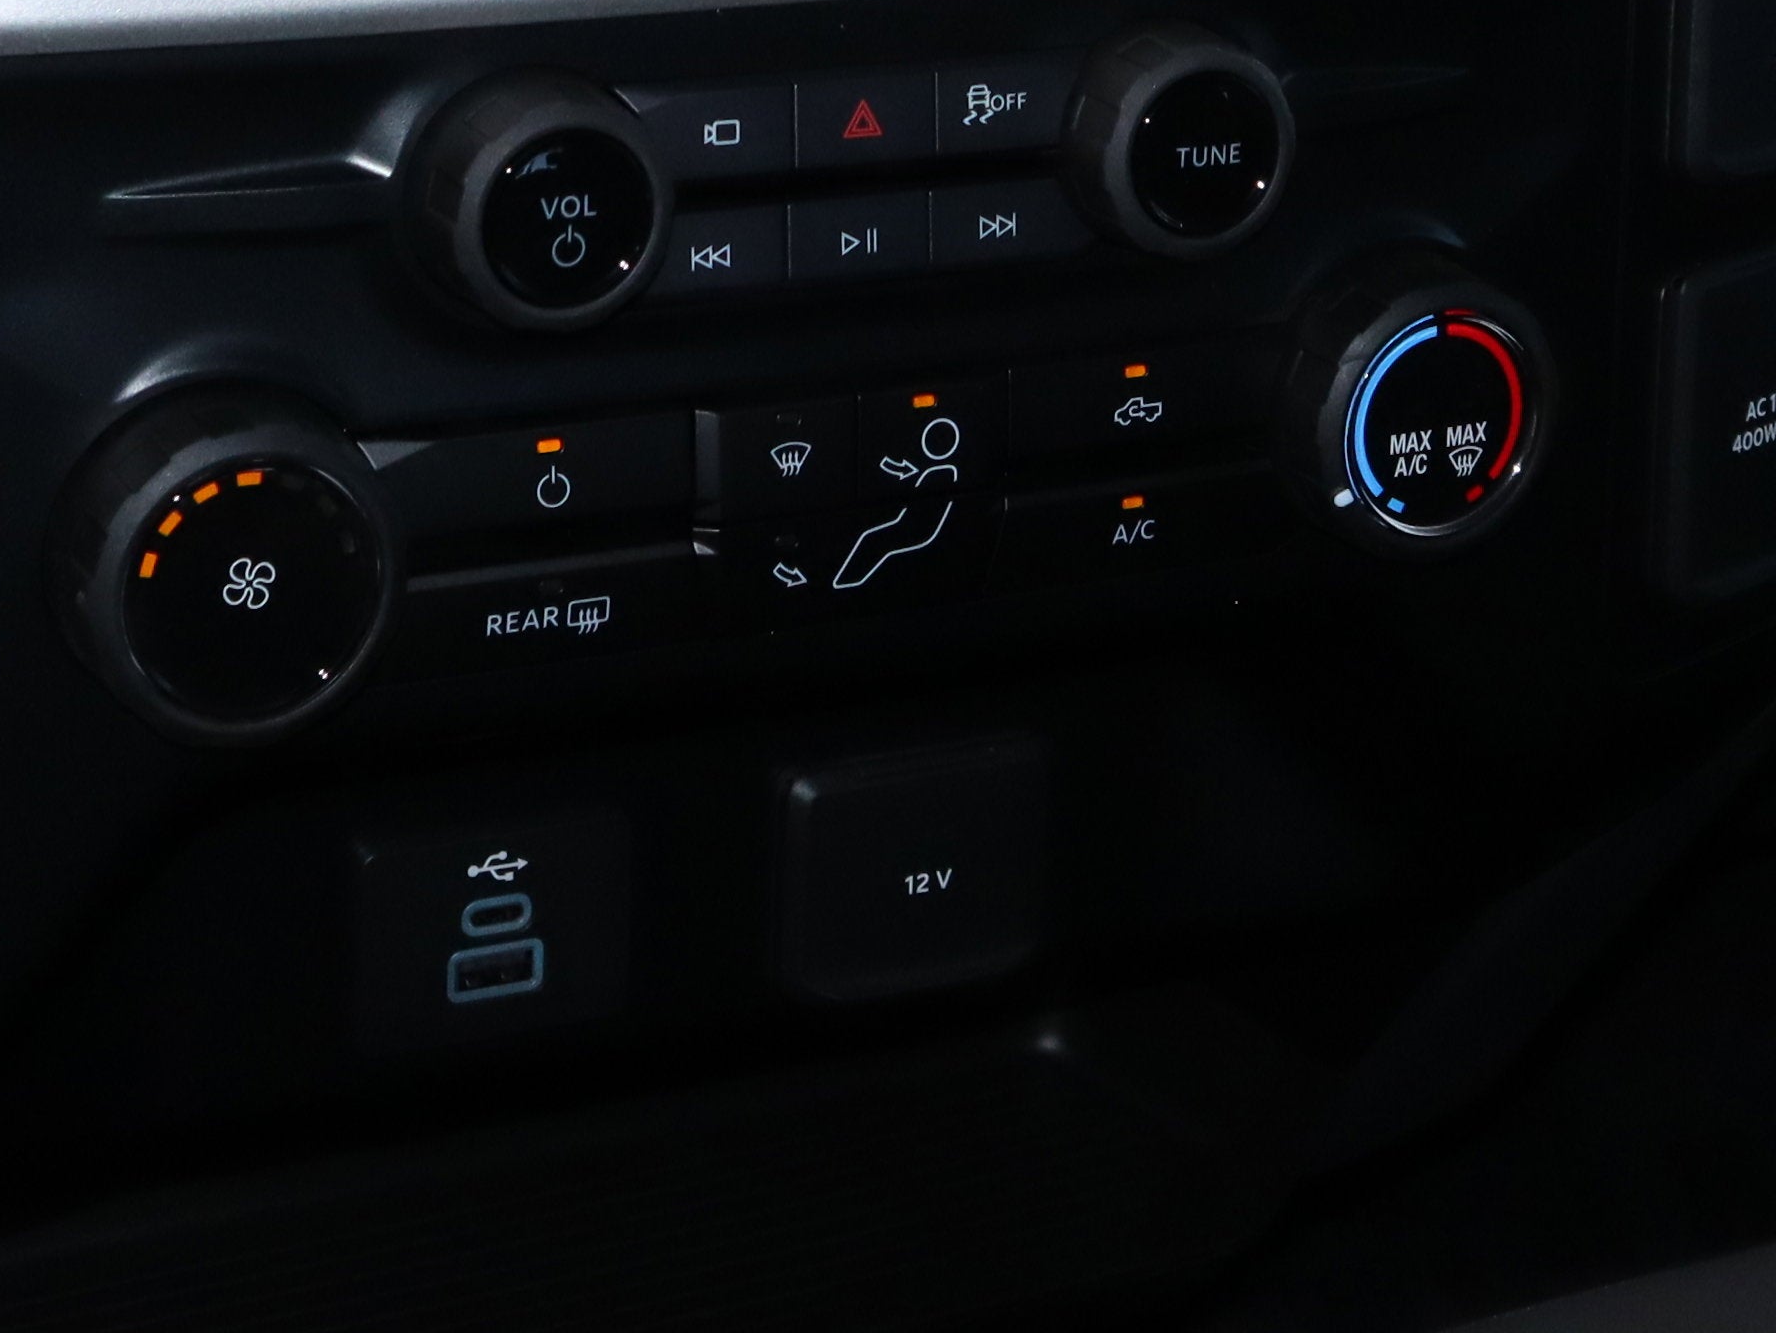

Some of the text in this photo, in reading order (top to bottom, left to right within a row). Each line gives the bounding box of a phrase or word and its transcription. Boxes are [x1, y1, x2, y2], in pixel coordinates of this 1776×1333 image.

[990, 93, 1027, 113] OFF
[1176, 143, 1241, 168] TUNE
[540, 194, 597, 220] VOL
[1745, 399, 1767, 421] AC
[1389, 429, 1432, 457] MAX
[1446, 420, 1487, 449] MAX
[1394, 450, 1428, 478] A/C
[1112, 519, 1155, 545] A/C
[486, 606, 559, 637] REAR
